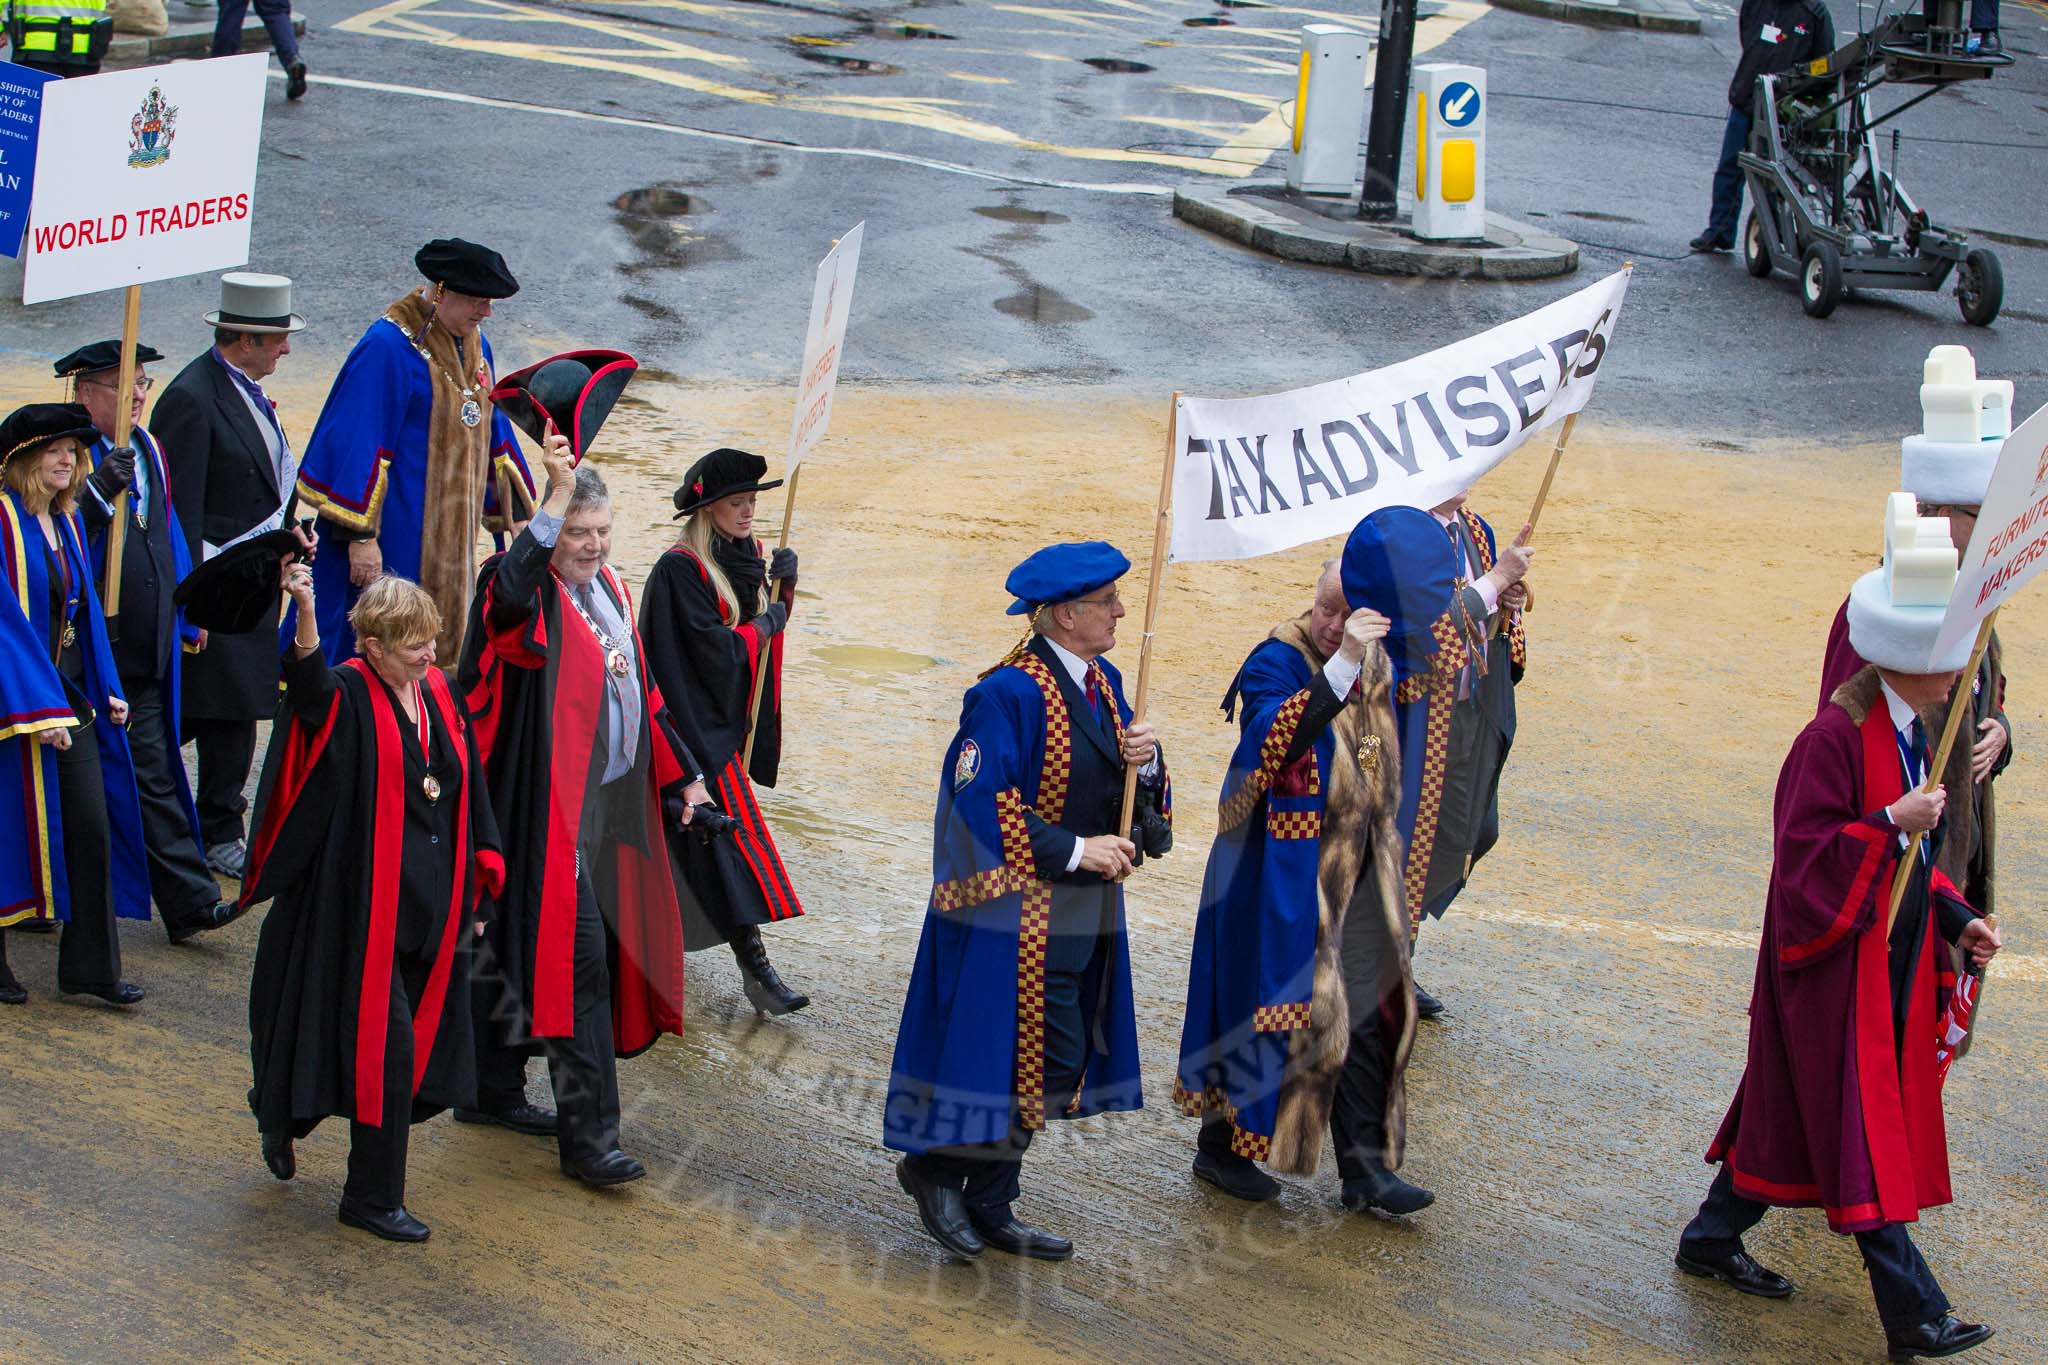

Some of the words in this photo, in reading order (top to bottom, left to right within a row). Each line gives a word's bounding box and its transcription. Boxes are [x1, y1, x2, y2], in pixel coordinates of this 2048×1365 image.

[0, 109, 34, 123] ADERS
[12, 98, 26, 107] OF
[35, 214, 127, 254] WORLD
[136, 193, 248, 236] TRADERS
[1187, 435, 1291, 520] TAX
[1293, 309, 1612, 506] ADVISERS
